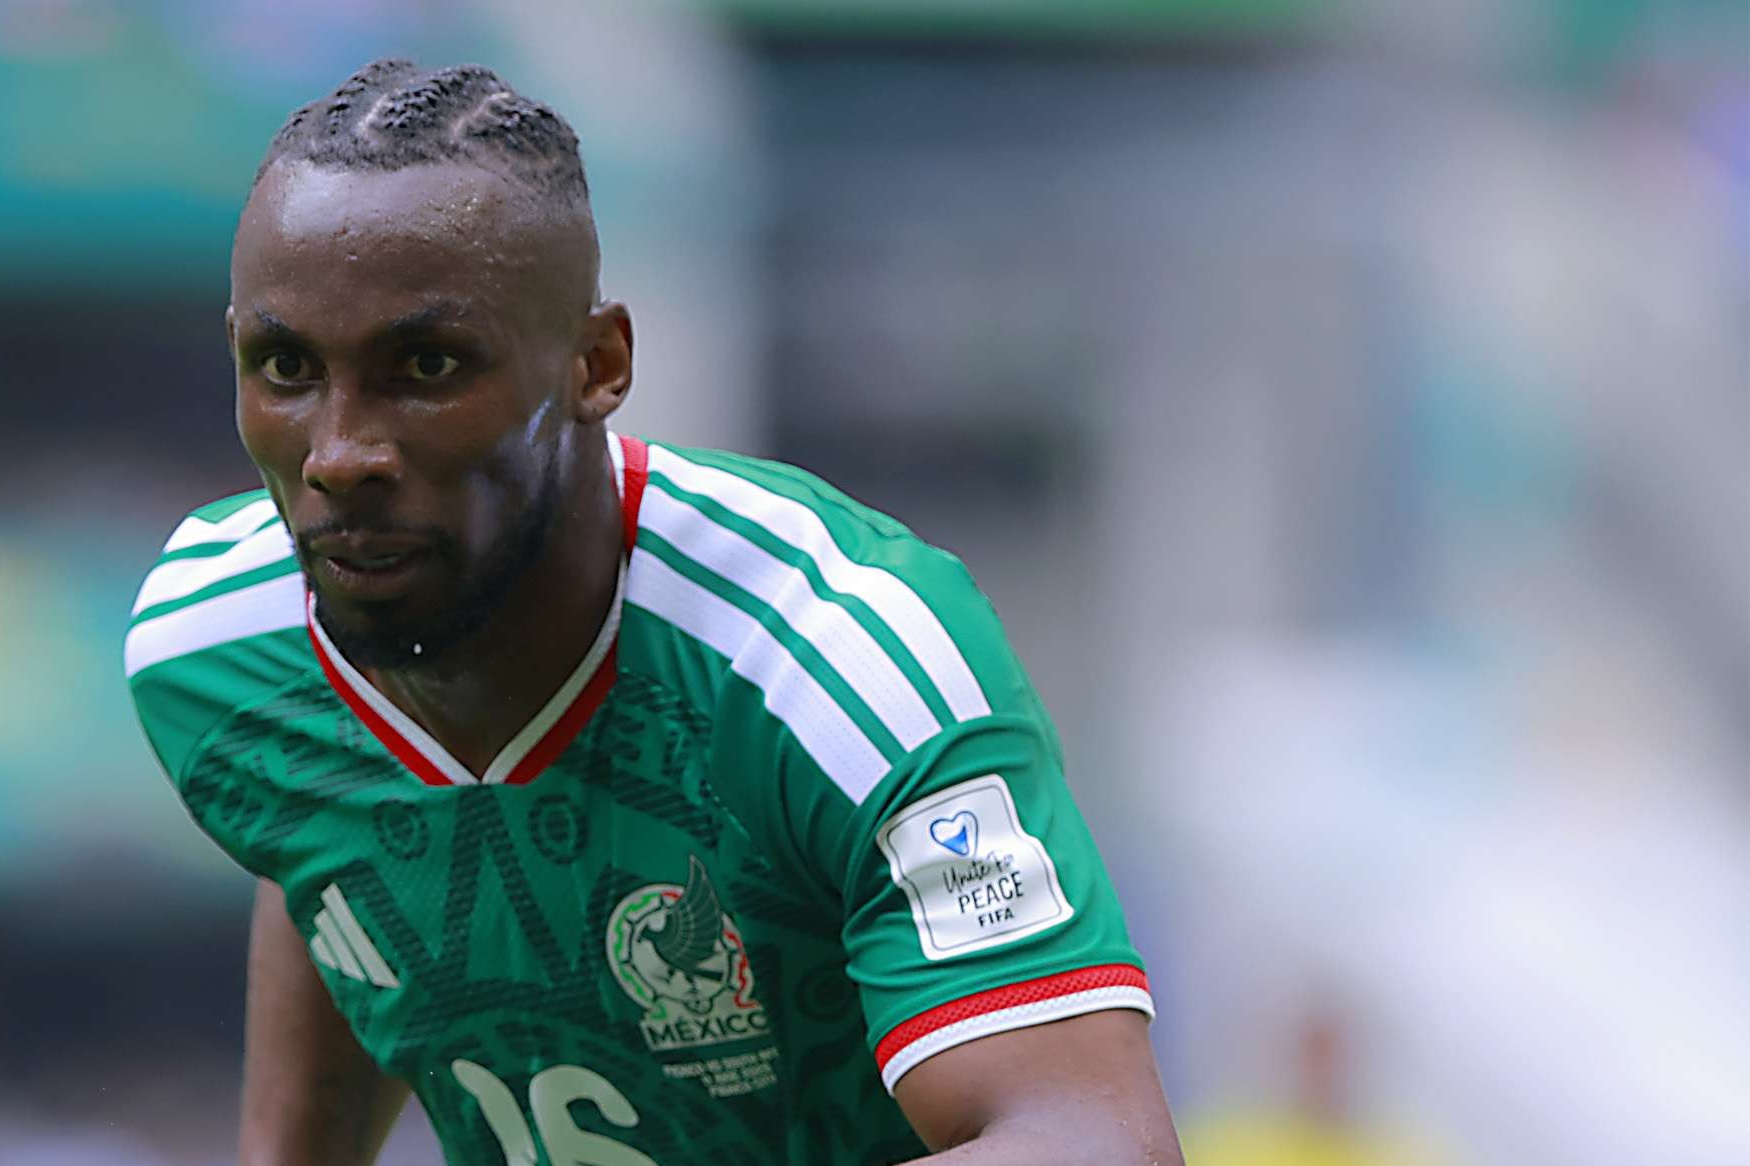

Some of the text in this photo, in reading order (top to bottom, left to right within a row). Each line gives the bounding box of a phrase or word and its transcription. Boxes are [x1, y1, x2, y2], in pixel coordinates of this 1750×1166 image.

[942, 860, 991, 893] Unite
[958, 871, 1025, 914] PEACE
[978, 907, 1015, 927] FIFA
